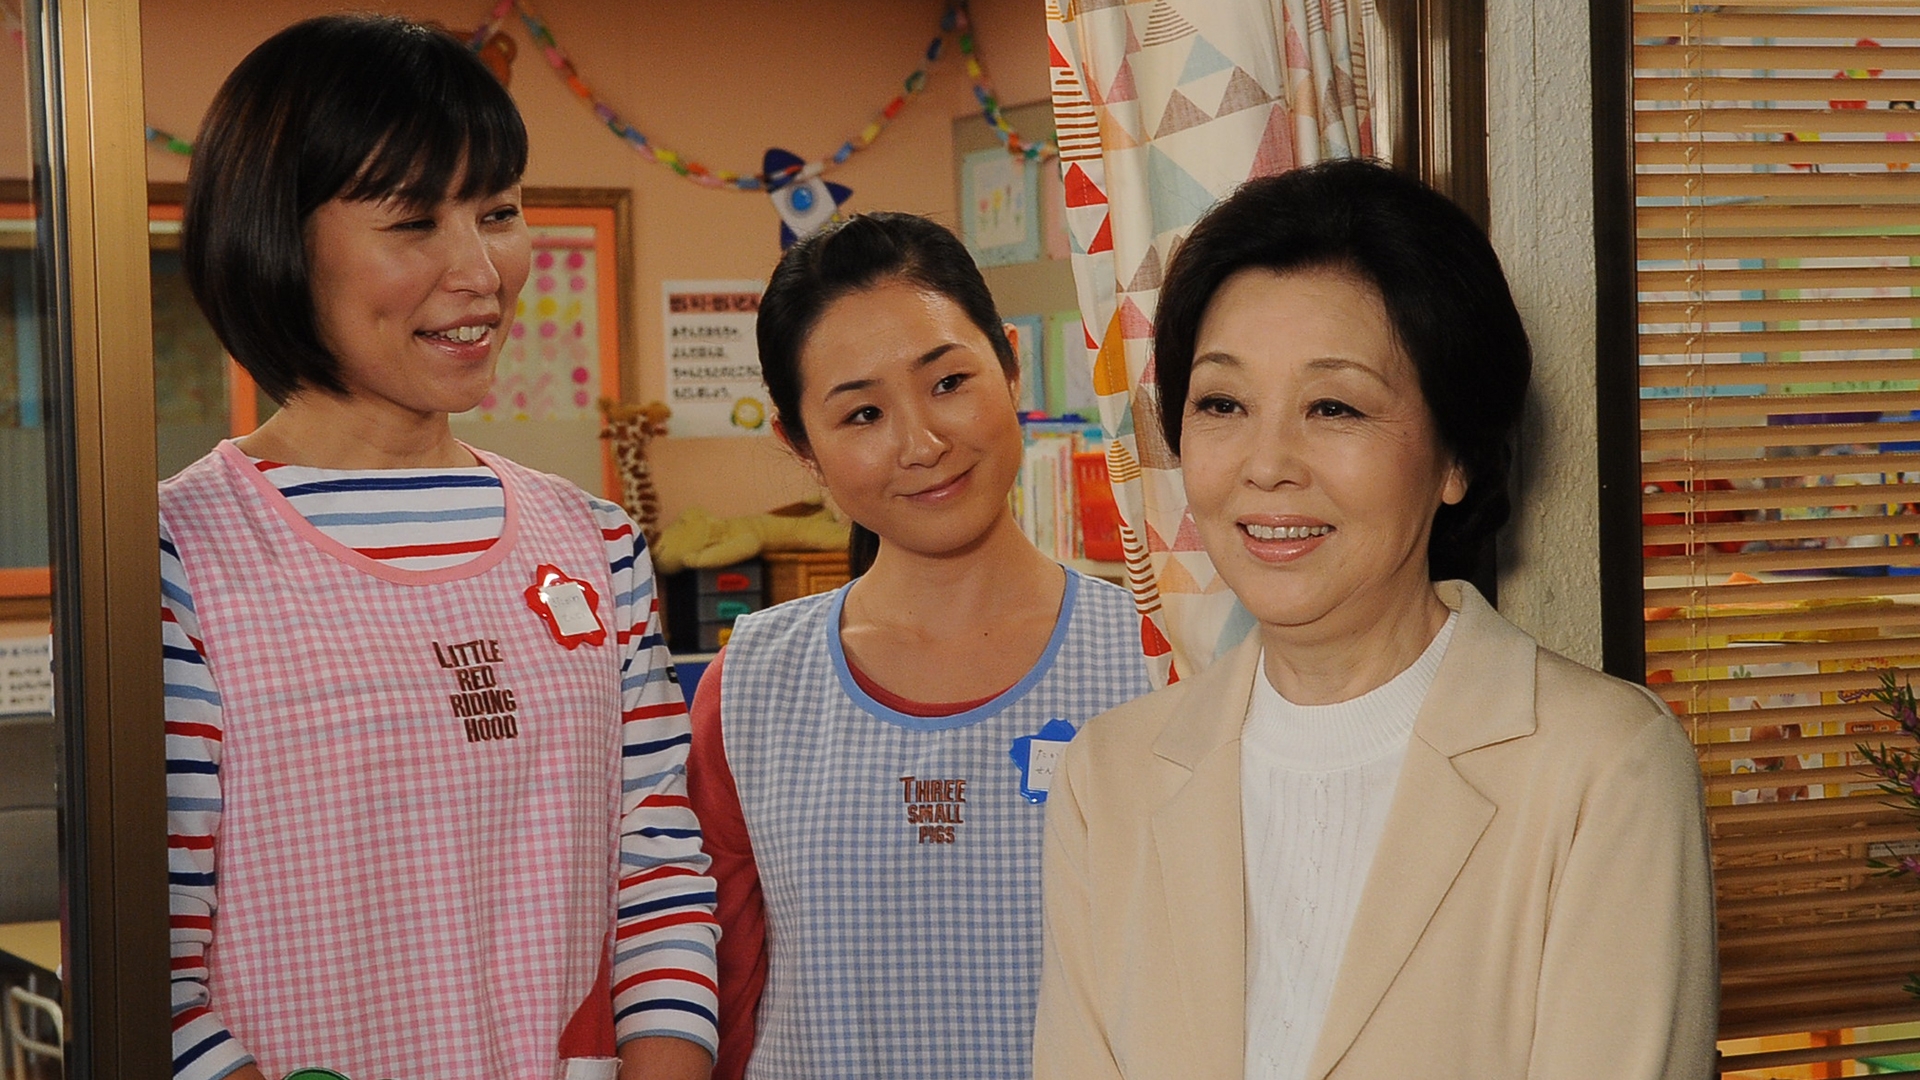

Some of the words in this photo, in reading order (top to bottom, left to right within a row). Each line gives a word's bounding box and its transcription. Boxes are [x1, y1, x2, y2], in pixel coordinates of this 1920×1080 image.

[432, 639, 504, 669] LITTLE
[455, 665, 496, 692] RED
[449, 689, 517, 718] RIDING
[464, 714, 519, 743] HOOD
[899, 776, 966, 803] THREE
[907, 804, 964, 824] SMALL
[919, 825, 956, 844] PIGS
